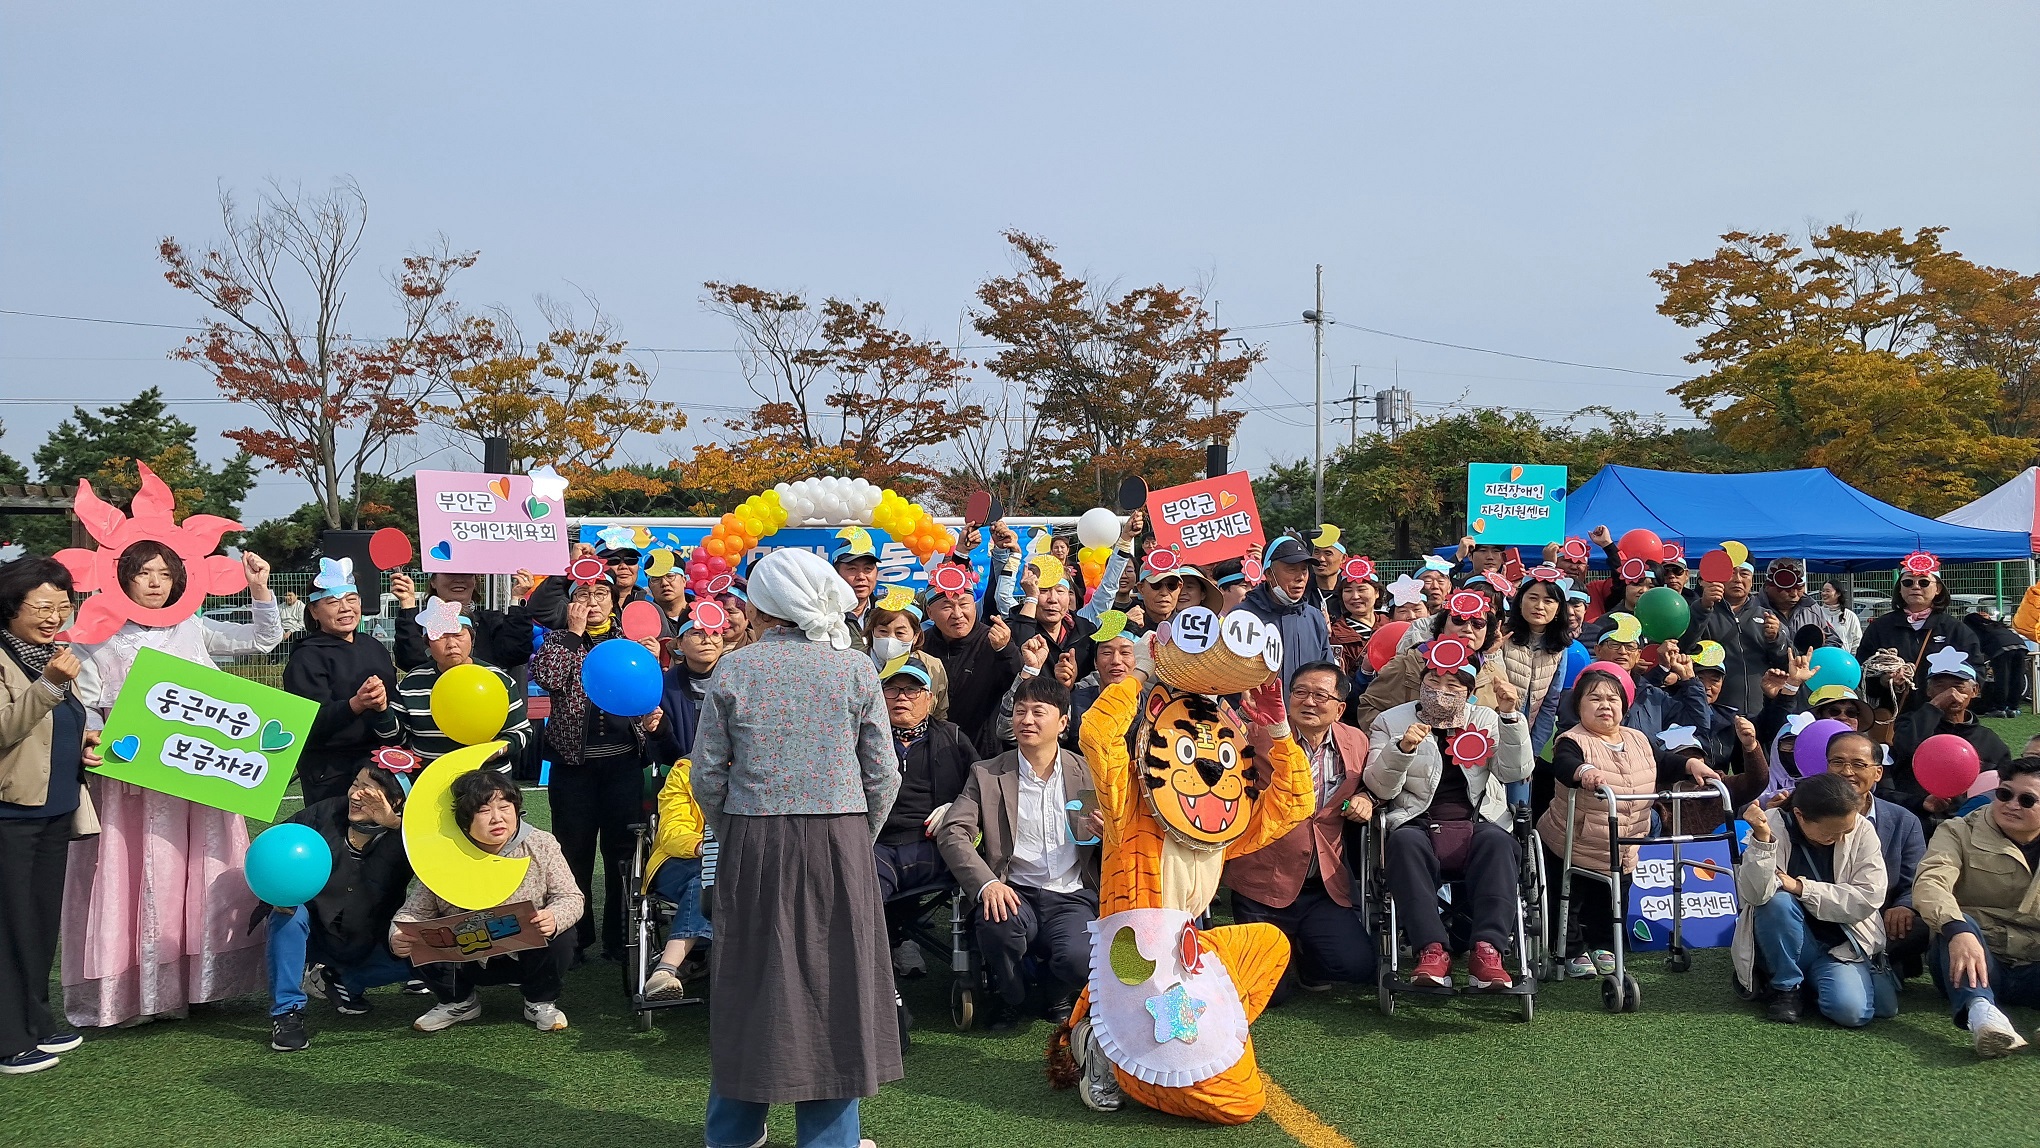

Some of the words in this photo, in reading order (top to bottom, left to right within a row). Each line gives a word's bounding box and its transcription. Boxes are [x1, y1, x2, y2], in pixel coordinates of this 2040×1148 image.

[439, 493, 493, 512] 부안군
[1485, 484, 1543, 499] 지적장애인
[1164, 494, 1214, 522] 부안군
[1481, 504, 1549, 519] 자립지원센터
[452, 522, 557, 541] 장애인체육회
[1182, 512, 1251, 547] 문화재단
[157, 688, 250, 737] 둥근마음
[168, 739, 263, 781] 보금자리
